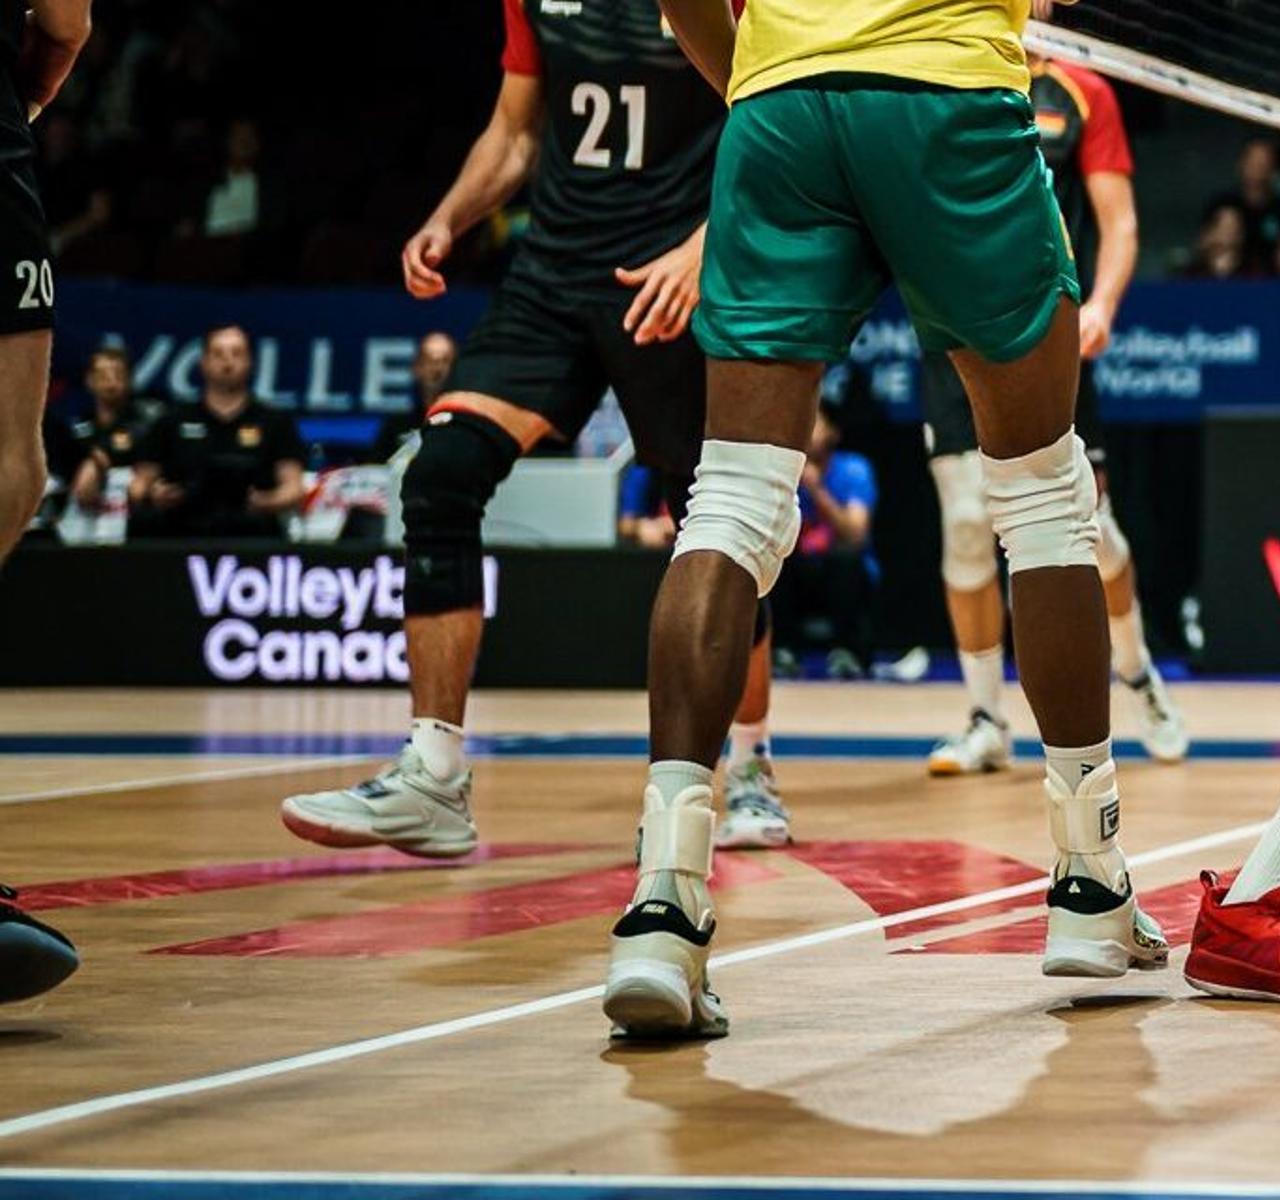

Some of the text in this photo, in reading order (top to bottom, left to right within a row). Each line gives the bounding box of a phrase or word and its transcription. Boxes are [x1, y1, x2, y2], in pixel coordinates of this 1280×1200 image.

[571, 81, 647, 171] 21
[16, 258, 54, 309] 20
[187, 554, 499, 630] Volleybl
